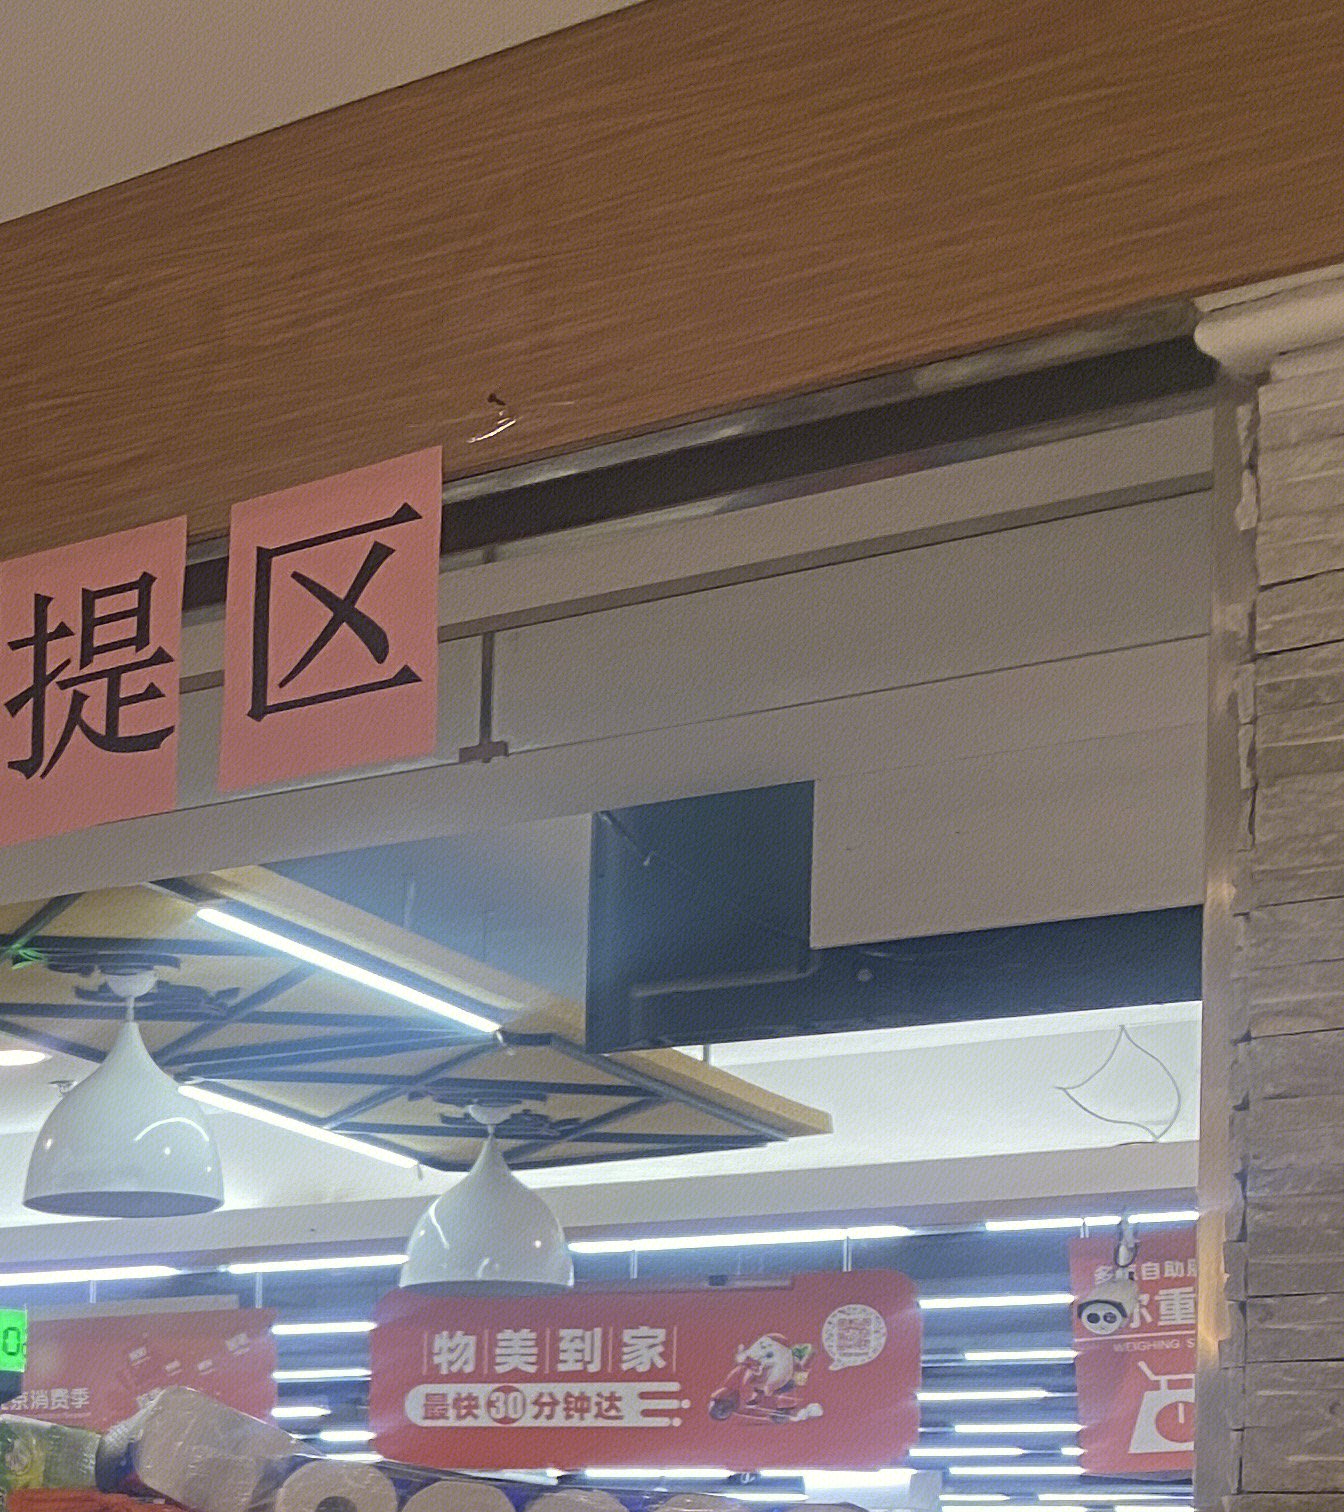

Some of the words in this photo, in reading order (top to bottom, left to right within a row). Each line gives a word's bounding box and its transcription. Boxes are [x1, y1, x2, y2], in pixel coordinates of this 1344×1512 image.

[432, 1326, 668, 1374] 物美到家
[0, 1387, 90, 1411] 京消费季
[422, 1385, 624, 1426] 最快30分钟达
